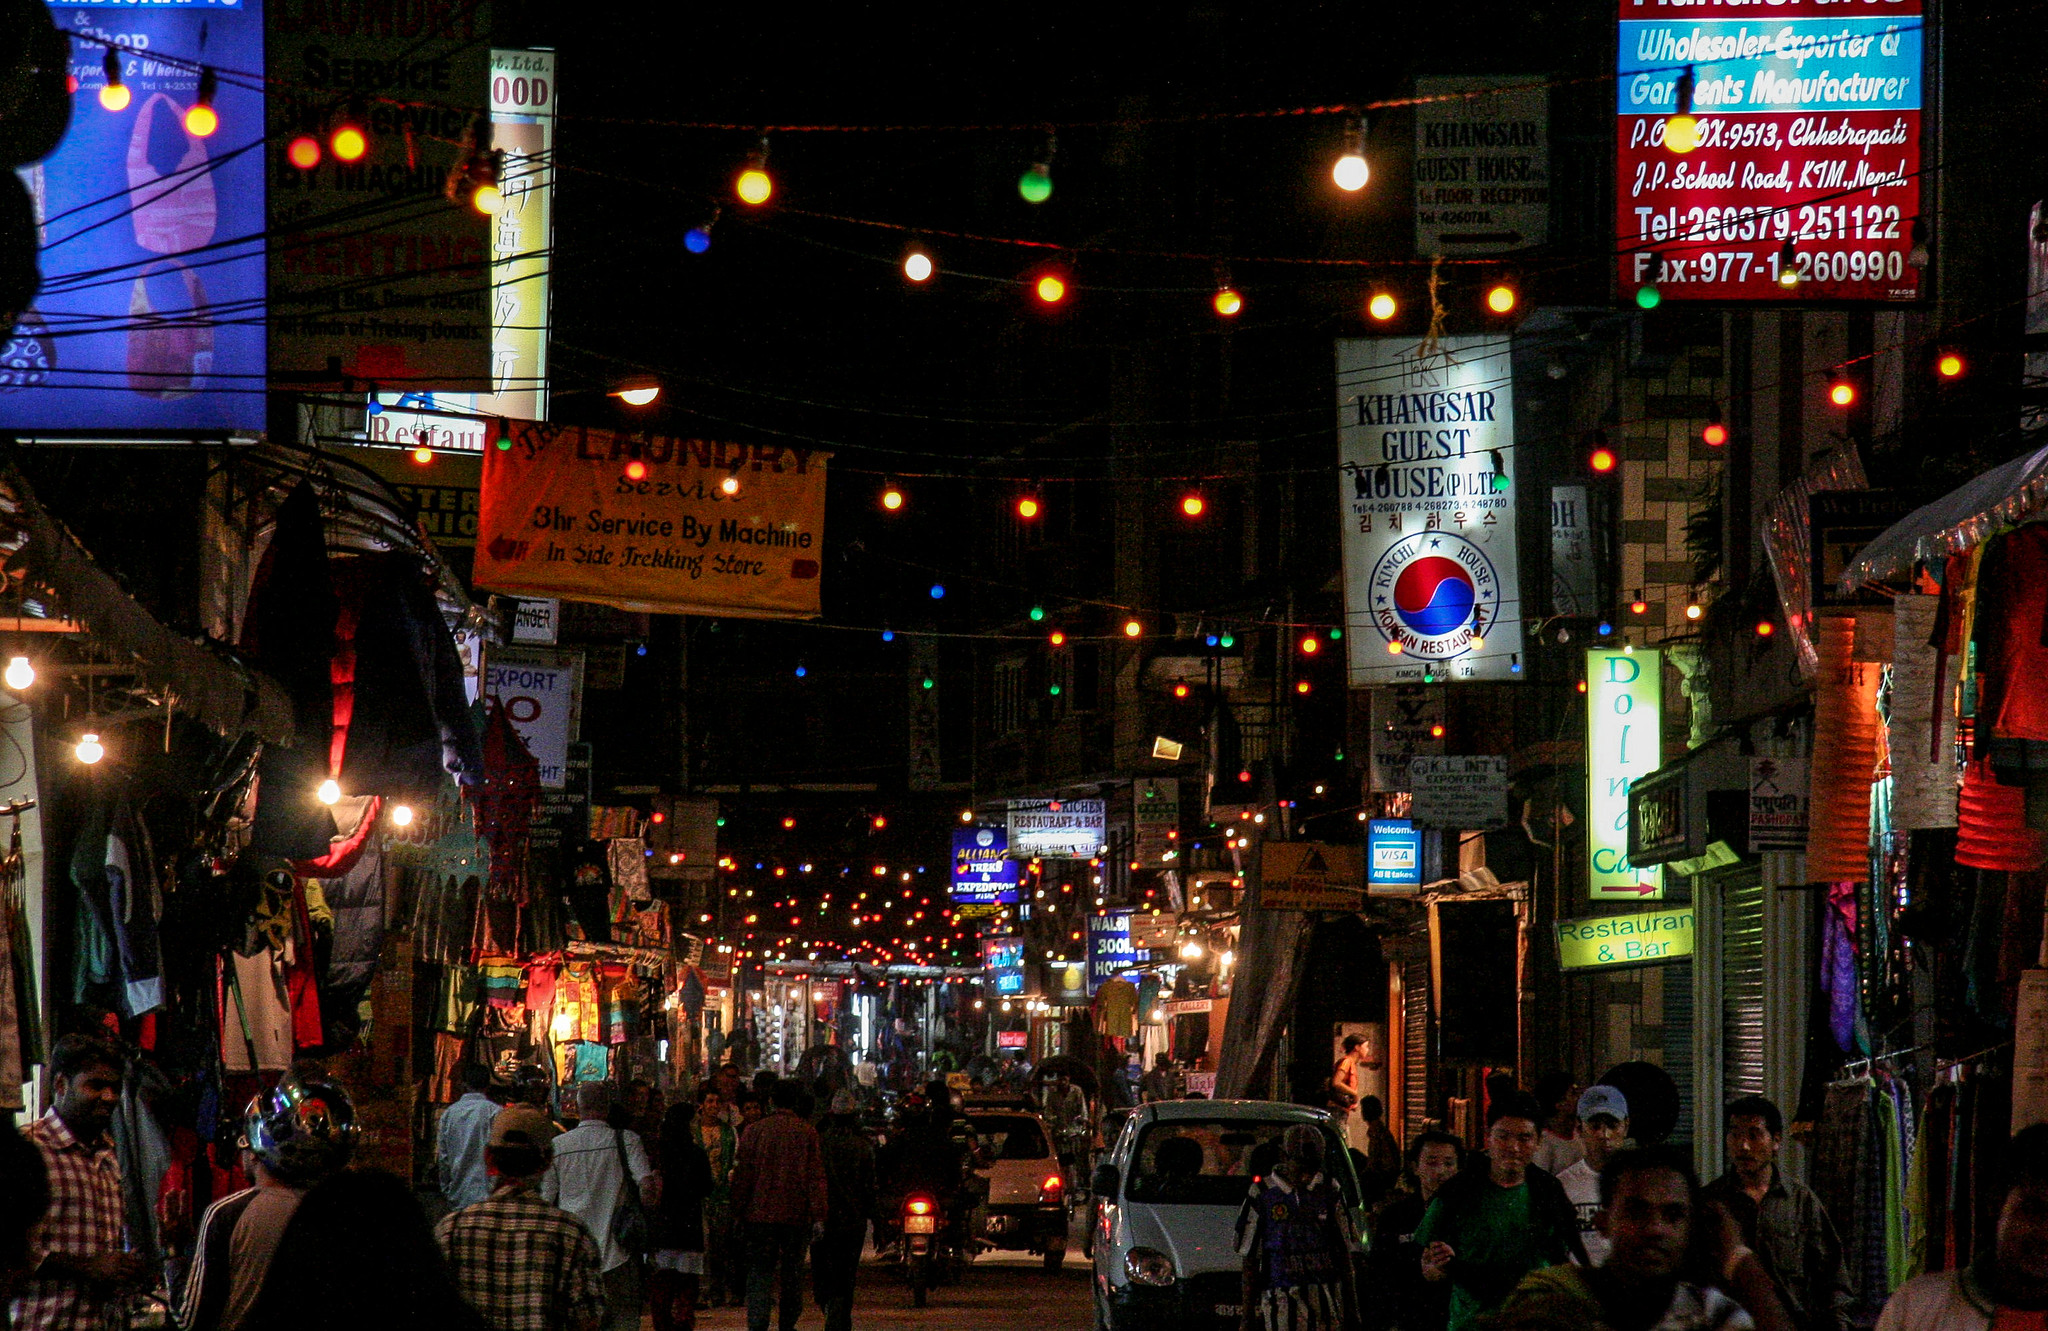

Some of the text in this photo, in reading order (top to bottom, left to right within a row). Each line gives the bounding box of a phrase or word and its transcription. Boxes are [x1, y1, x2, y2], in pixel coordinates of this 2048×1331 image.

[79, 27, 149, 55] Shop
[1637, 25, 1899, 67] Wholesaler-Exporter &
[125, 60, 138, 77] &
[303, 45, 450, 90] SERVICE
[1630, 70, 1910, 106] Garents Manufacturer
[1425, 123, 1537, 147] KHANGSAR
[1686, 118, 1783, 150] OX:9513,
[1788, 117, 1907, 155] Chhetrapati
[336, 163, 448, 194] MACHIN
[1416, 157, 1471, 182] GUEST
[1478, 157, 1531, 182] HOUSE
[1741, 160, 1792, 192] Road,
[1435, 189, 1474, 204] FLOOR
[1481, 188, 1548, 204] RECEPTION
[284, 231, 483, 278] RENTING
[1634, 251, 1903, 283] Fax:977-1260990
[1358, 391, 1496, 425] KHANGSAR
[577, 426, 813, 474] LAUNDRY
[1382, 428, 1471, 461] GUEST
[532, 505, 813, 549] 3hr Service By Machine
[546, 541, 767, 581] In Side Trekking Store
[1375, 542, 1492, 589] KIMCHI HOUSE
[1420, 605, 1490, 654] RESTAURNT
[486, 667, 558, 691] EXPORT
[1395, 670, 1422, 679] KIMCHI
[1428, 668, 1450, 678] OUSE
[538, 766, 559, 780] HT
[1014, 816, 1072, 828] RESTAURANT
[1085, 816, 1104, 828] BAR
[957, 847, 1010, 861] ALLIANC
[1381, 850, 1409, 861] VISA
[1559, 912, 1695, 943] Restauran
[1597, 939, 1672, 963] & Bar
